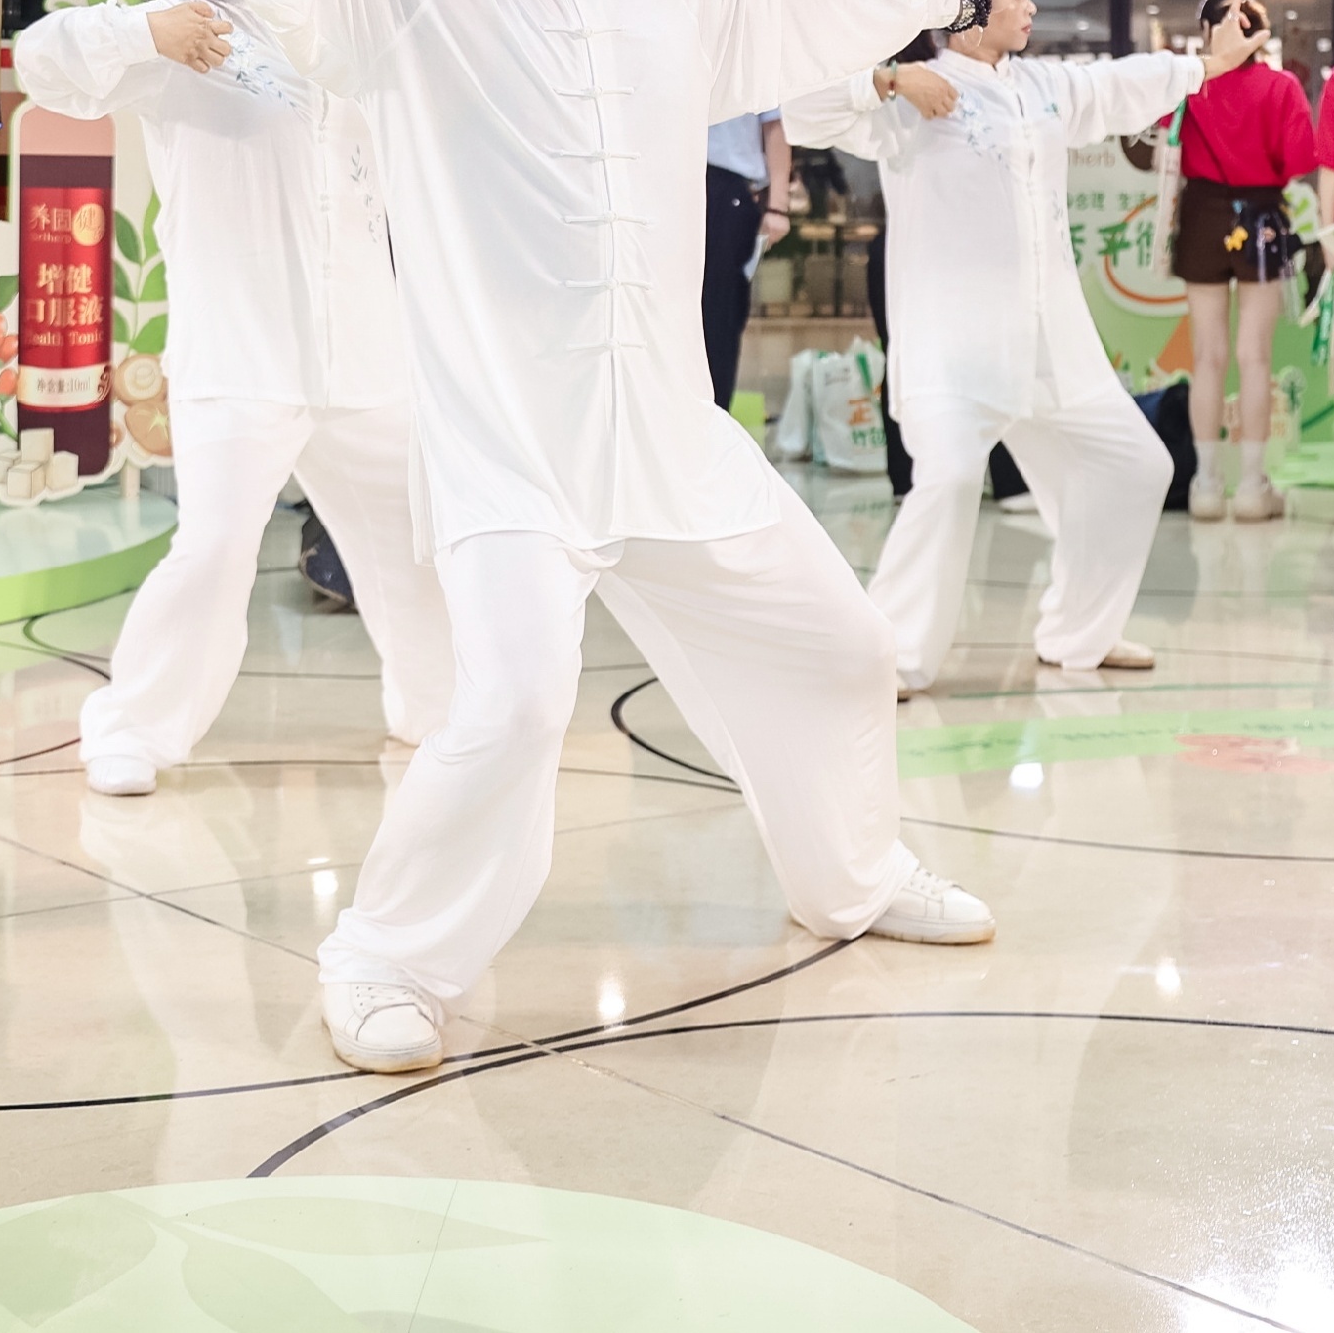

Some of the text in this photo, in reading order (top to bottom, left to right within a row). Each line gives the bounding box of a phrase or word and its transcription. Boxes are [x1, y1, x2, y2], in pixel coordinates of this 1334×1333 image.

[37, 263, 93, 295] 增健
[26, 295, 105, 327] 口服液
